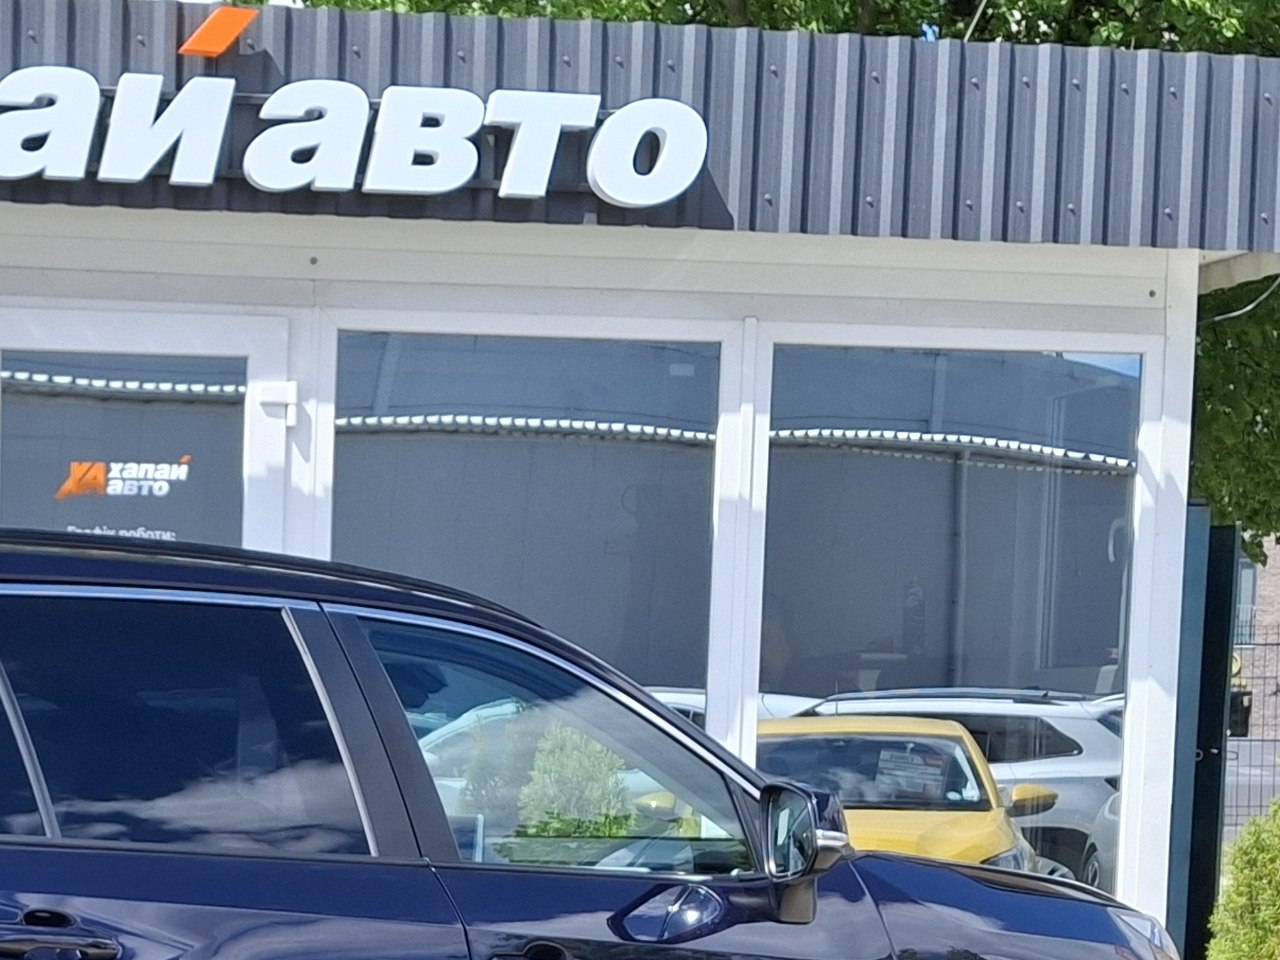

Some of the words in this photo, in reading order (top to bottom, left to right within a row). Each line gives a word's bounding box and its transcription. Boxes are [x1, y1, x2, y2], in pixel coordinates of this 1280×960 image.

[245, 77, 709, 209] авто
[107, 455, 193, 481] хапай
[106, 478, 170, 497] авто
